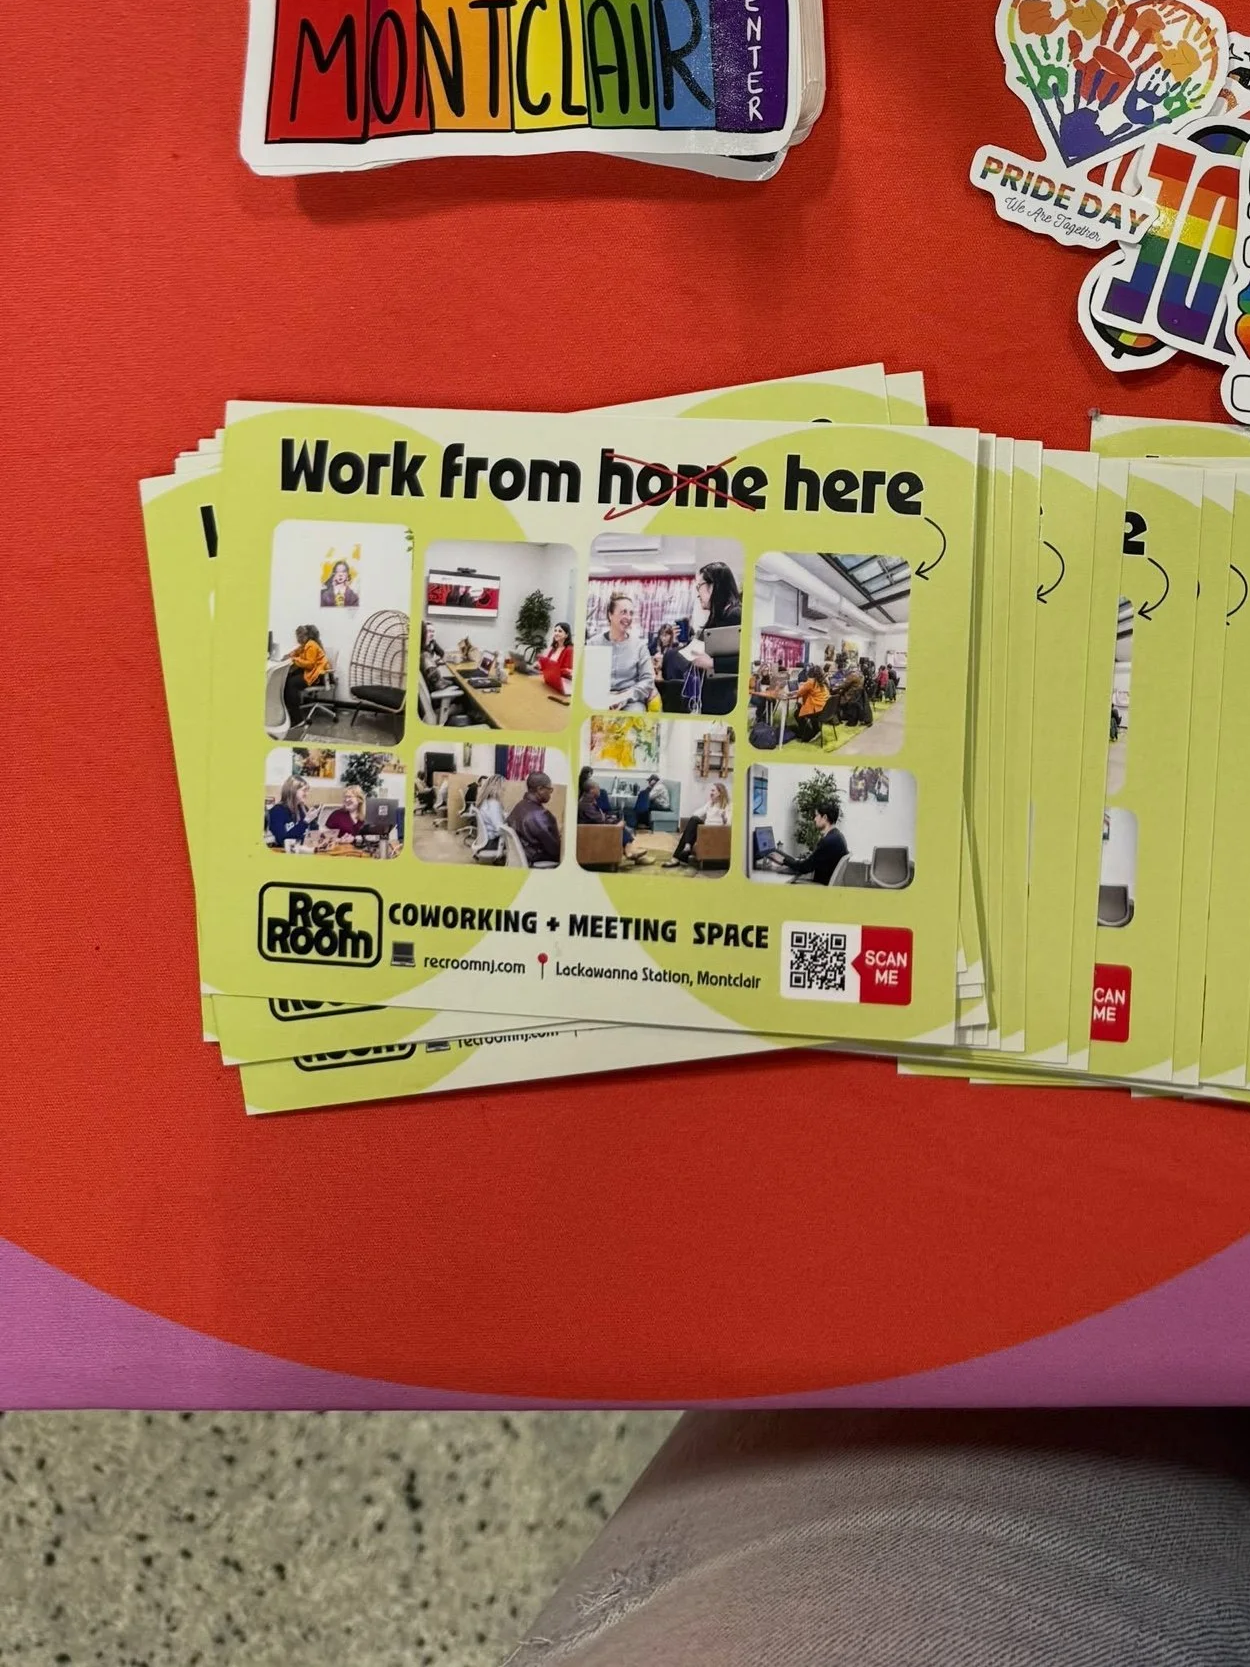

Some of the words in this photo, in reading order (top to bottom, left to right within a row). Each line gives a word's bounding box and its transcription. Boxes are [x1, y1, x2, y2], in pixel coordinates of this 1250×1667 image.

[979, 155, 1075, 210] PRIDE
[1077, 192, 1149, 236] DAY
[1004, 196, 1026, 214] We
[1027, 205, 1052, 224] Are
[1053, 212, 1102, 243] Together
[280, 437, 428, 498] Work
[439, 442, 581, 504] from
[597, 447, 768, 511] home
[784, 453, 924, 516] here
[288, 890, 354, 931] Rec
[388, 902, 538, 935] COWORKING
[568, 913, 677, 943] MEETING
[692, 921, 769, 949] SPACE
[266, 916, 374, 960] Room
[865, 949, 908, 968] SCAN
[423, 954, 527, 975] recroomnj.com
[555, 961, 638, 982] Lackawanna
[641, 966, 694, 988] Station,
[697, 970, 762, 990] Montclair
[874, 969, 899, 986] ME
[1093, 1005, 1117, 1022] ME
